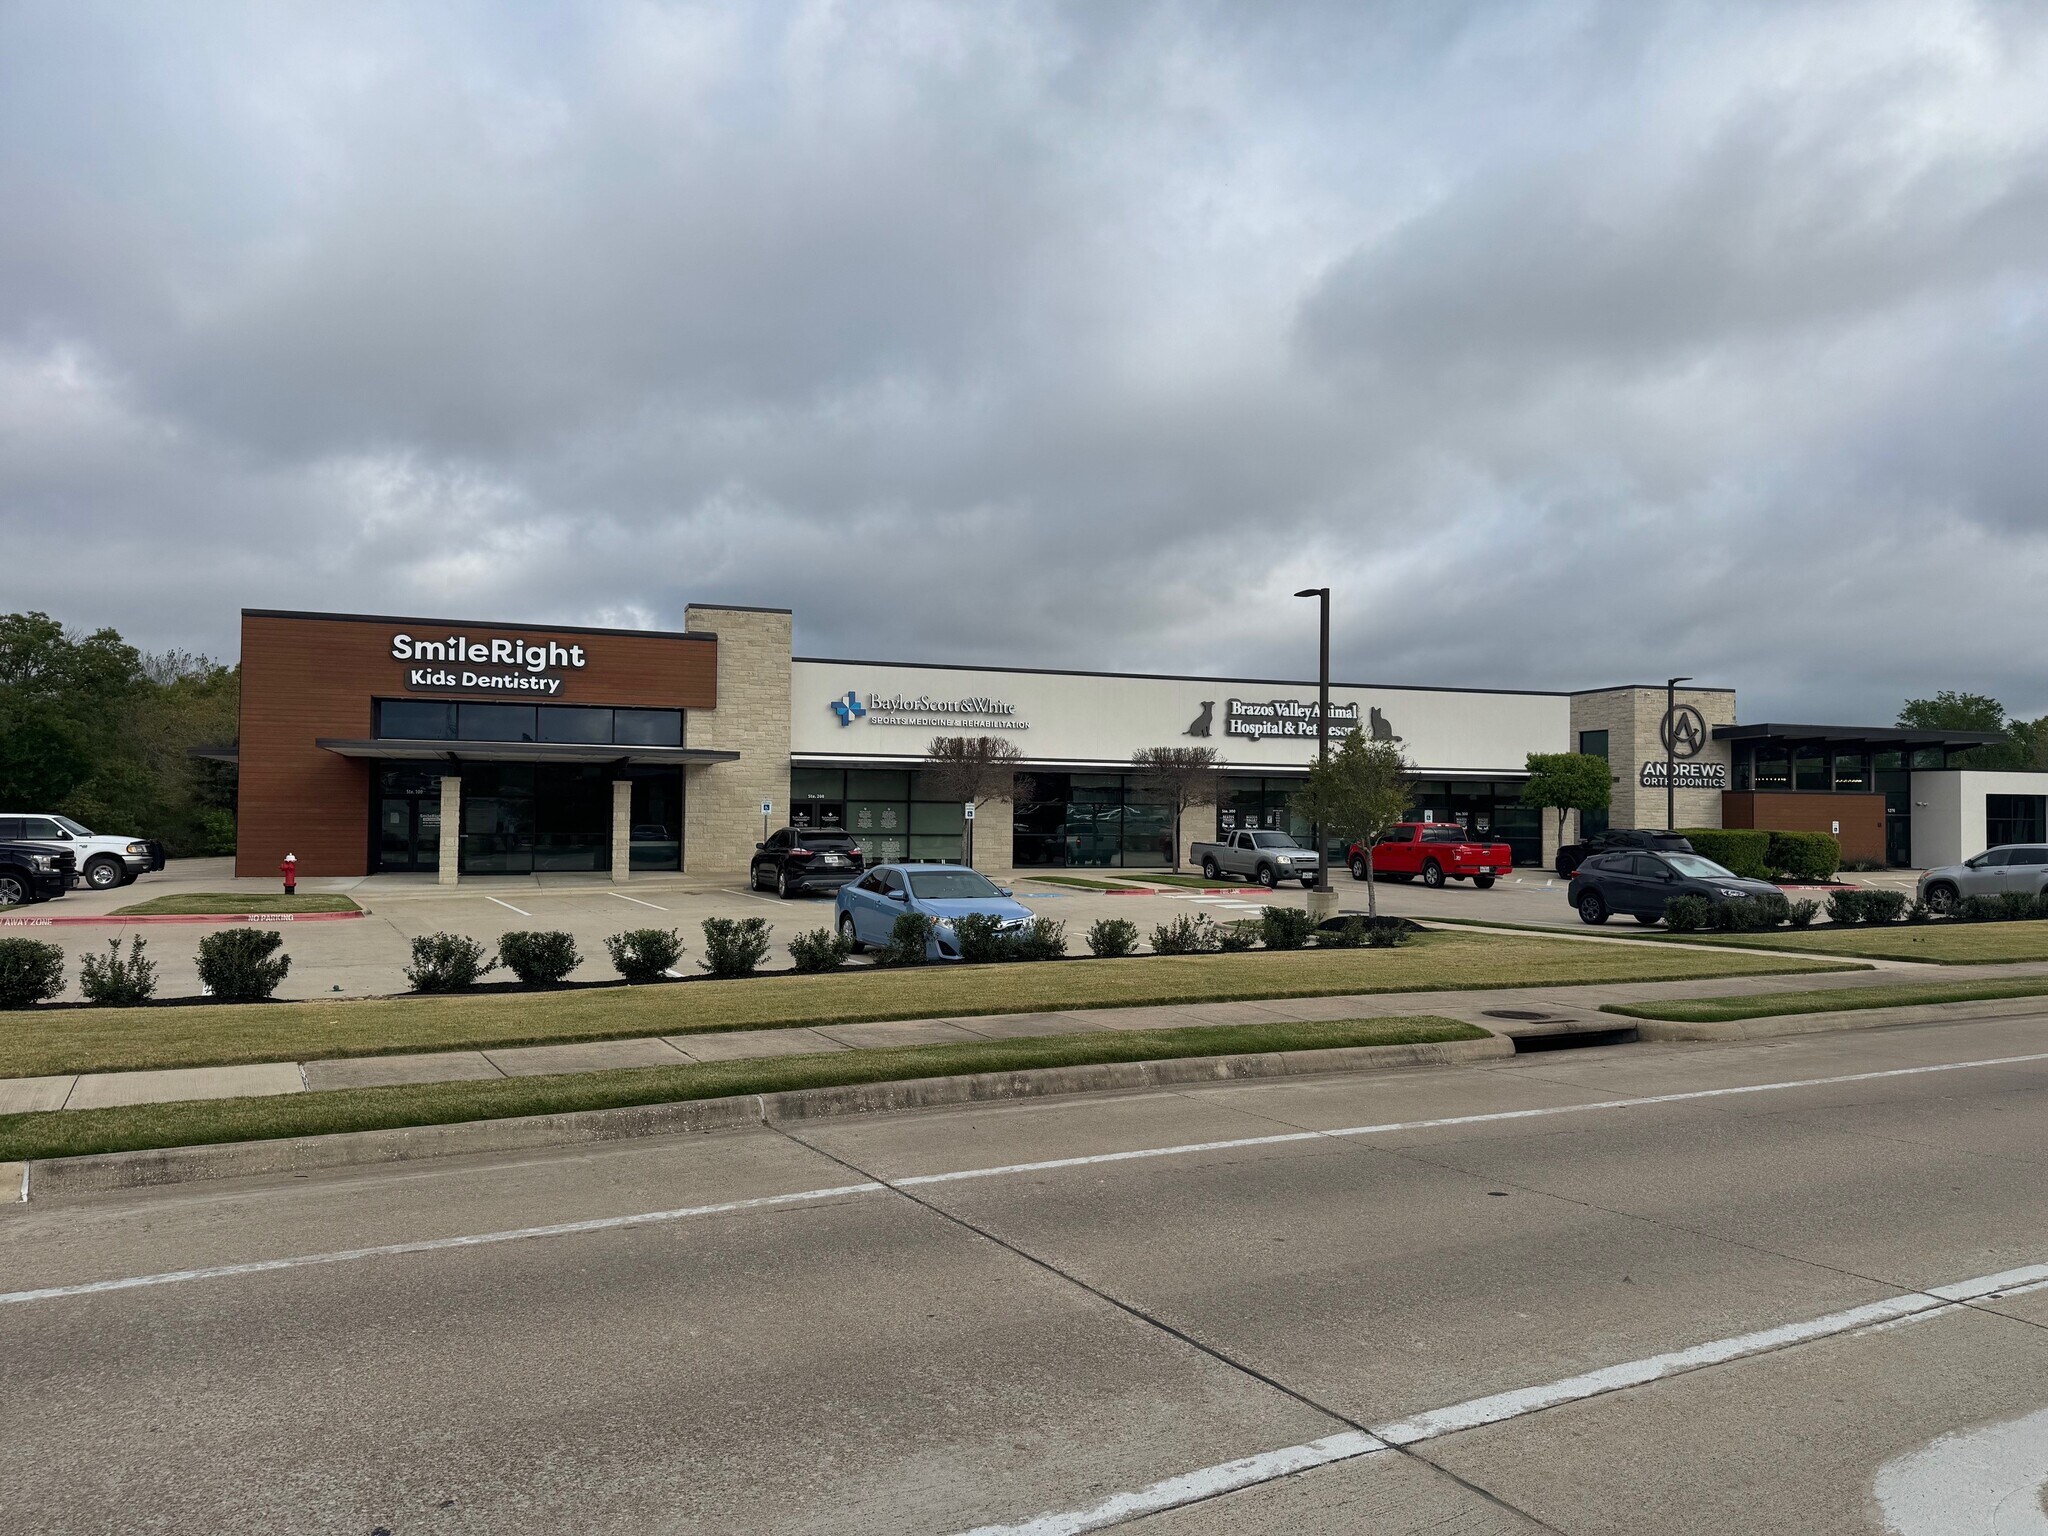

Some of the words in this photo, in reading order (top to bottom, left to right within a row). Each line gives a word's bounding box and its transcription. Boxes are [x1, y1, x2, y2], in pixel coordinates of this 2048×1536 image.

[392, 634, 586, 673] SmileRight
[411, 668, 456, 687] Kids
[462, 671, 561, 694] Dentistry
[1231, 701, 1274, 716] Brazos
[1273, 702, 1312, 722] Valley
[871, 716, 908, 725] SPORTS
[909, 718, 951, 726] MEDICINE
[962, 720, 1031, 729] REHABILITATION
[1230, 720, 1283, 738] Hospital
[1284, 721, 1296, 735] &
[1297, 721, 1318, 736] Pet
[1323, 724, 1358, 737] esor
[1643, 763, 1725, 777] ANDREWS
[1643, 777, 1726, 787] ORTHODONTICS
[4, 918, 29, 926] AWAY
[30, 918, 53, 926] ZONE
[248, 914, 259, 922] NO
[260, 913, 294, 921] PARKING
